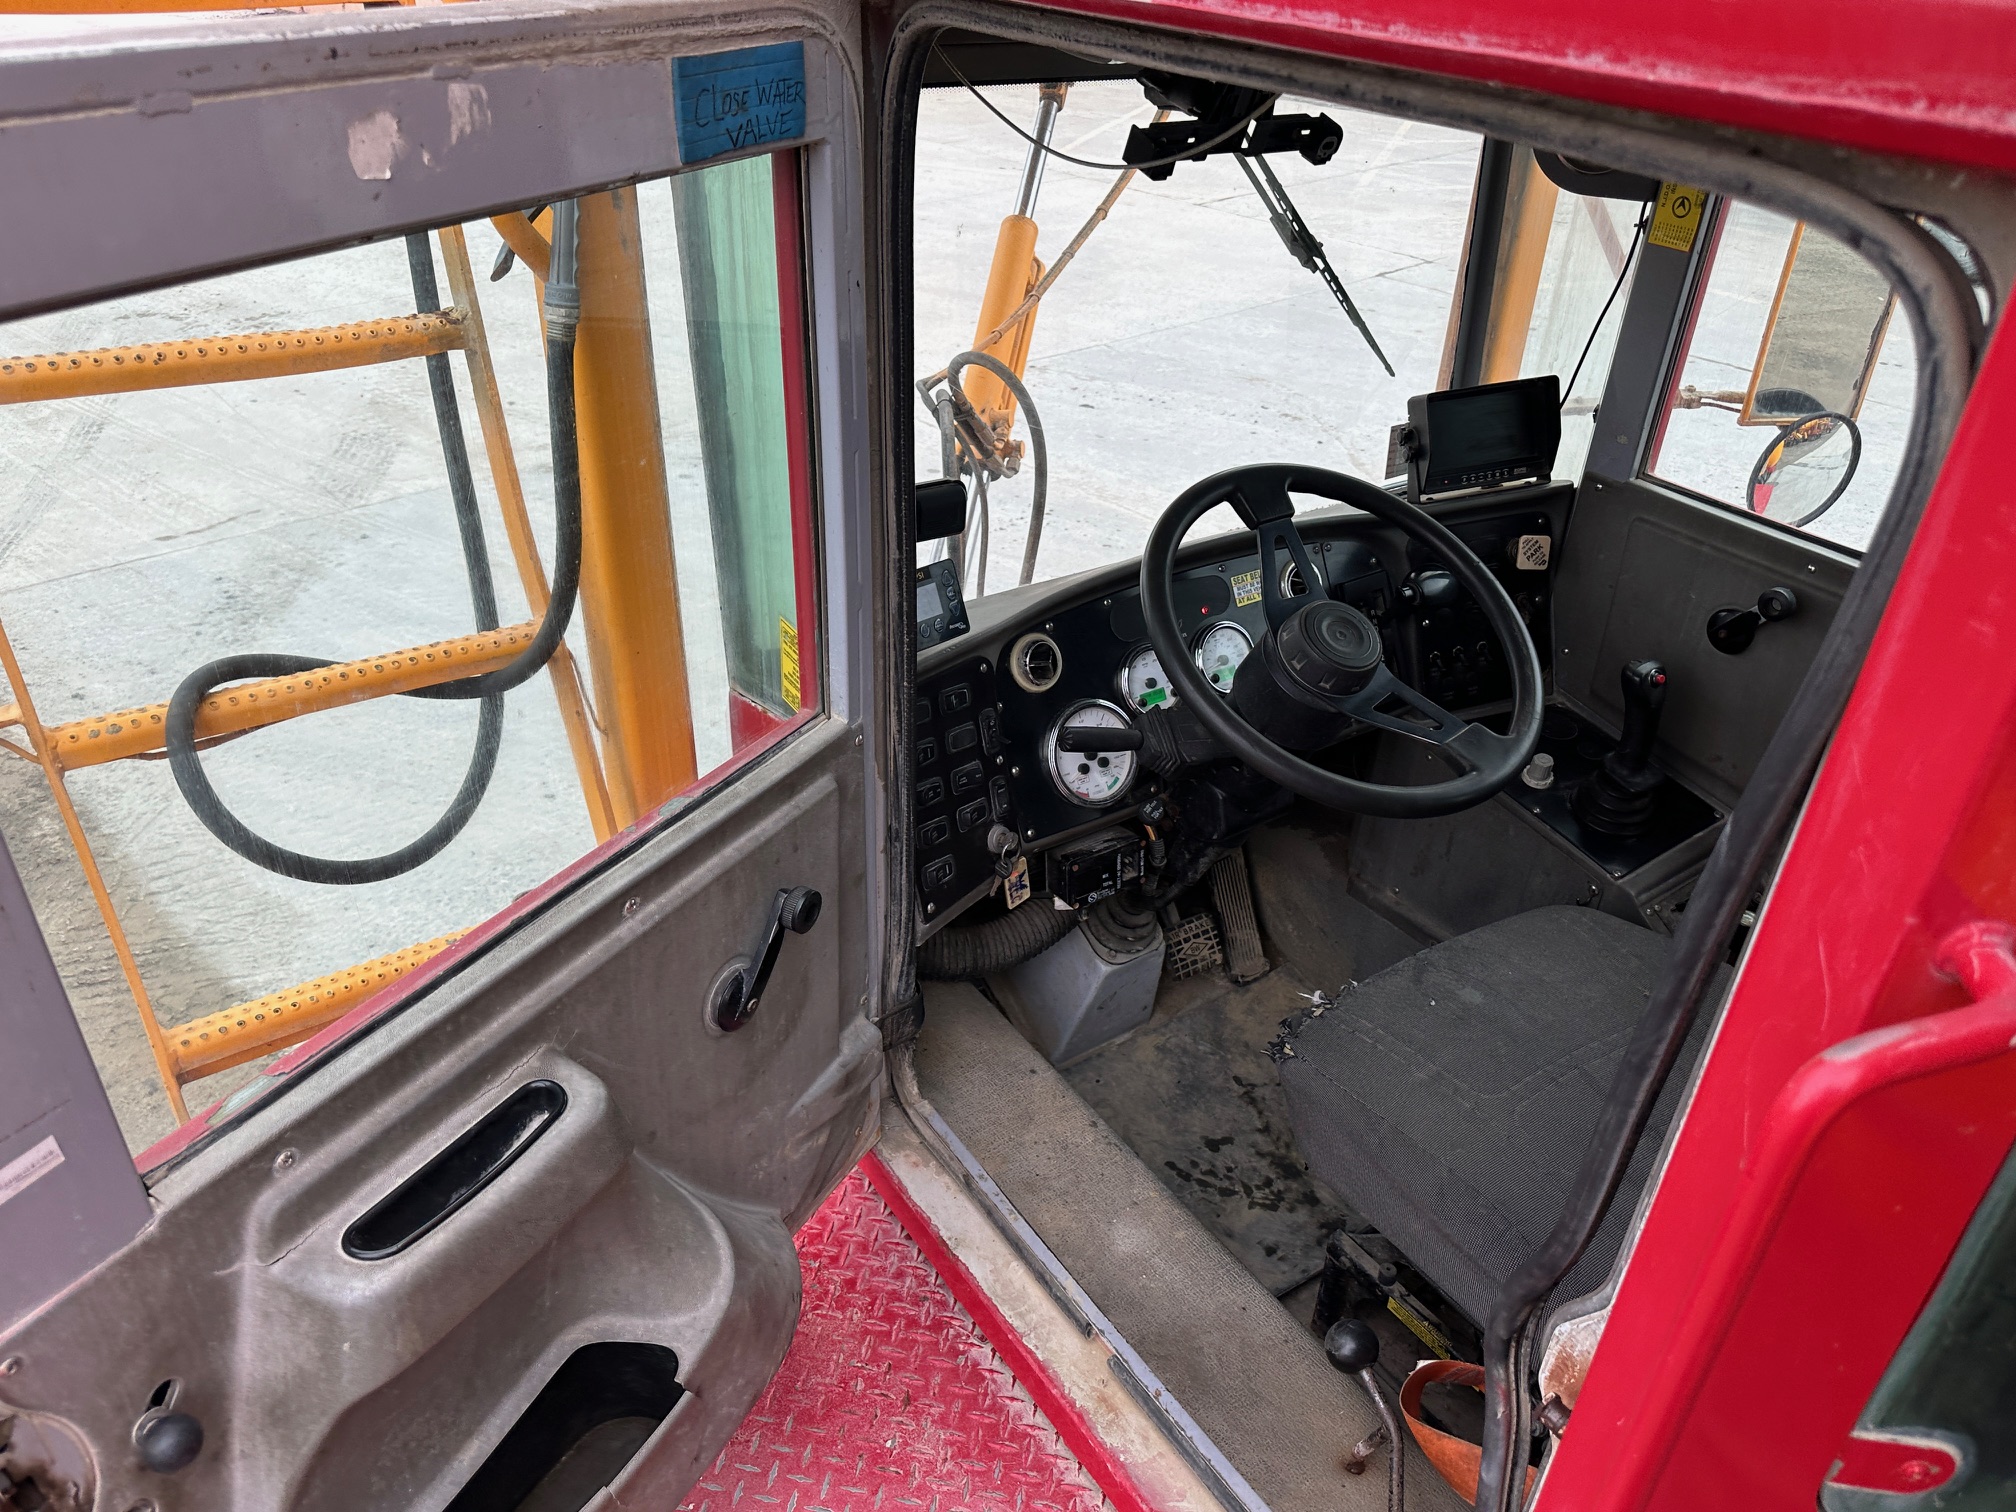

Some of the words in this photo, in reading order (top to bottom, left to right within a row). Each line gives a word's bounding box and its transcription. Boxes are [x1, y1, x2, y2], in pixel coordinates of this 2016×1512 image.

[695, 83, 750, 128] CLOSE
[756, 78, 807, 108] WATER
[726, 109, 793, 148] VALVE
[1525, 543, 1544, 562] PARK
[1232, 574, 1249, 586] SEAT
[1238, 597, 1246, 605] AT
[1246, 594, 1256, 602] ALL
[1183, 920, 1209, 935] BRAKE
